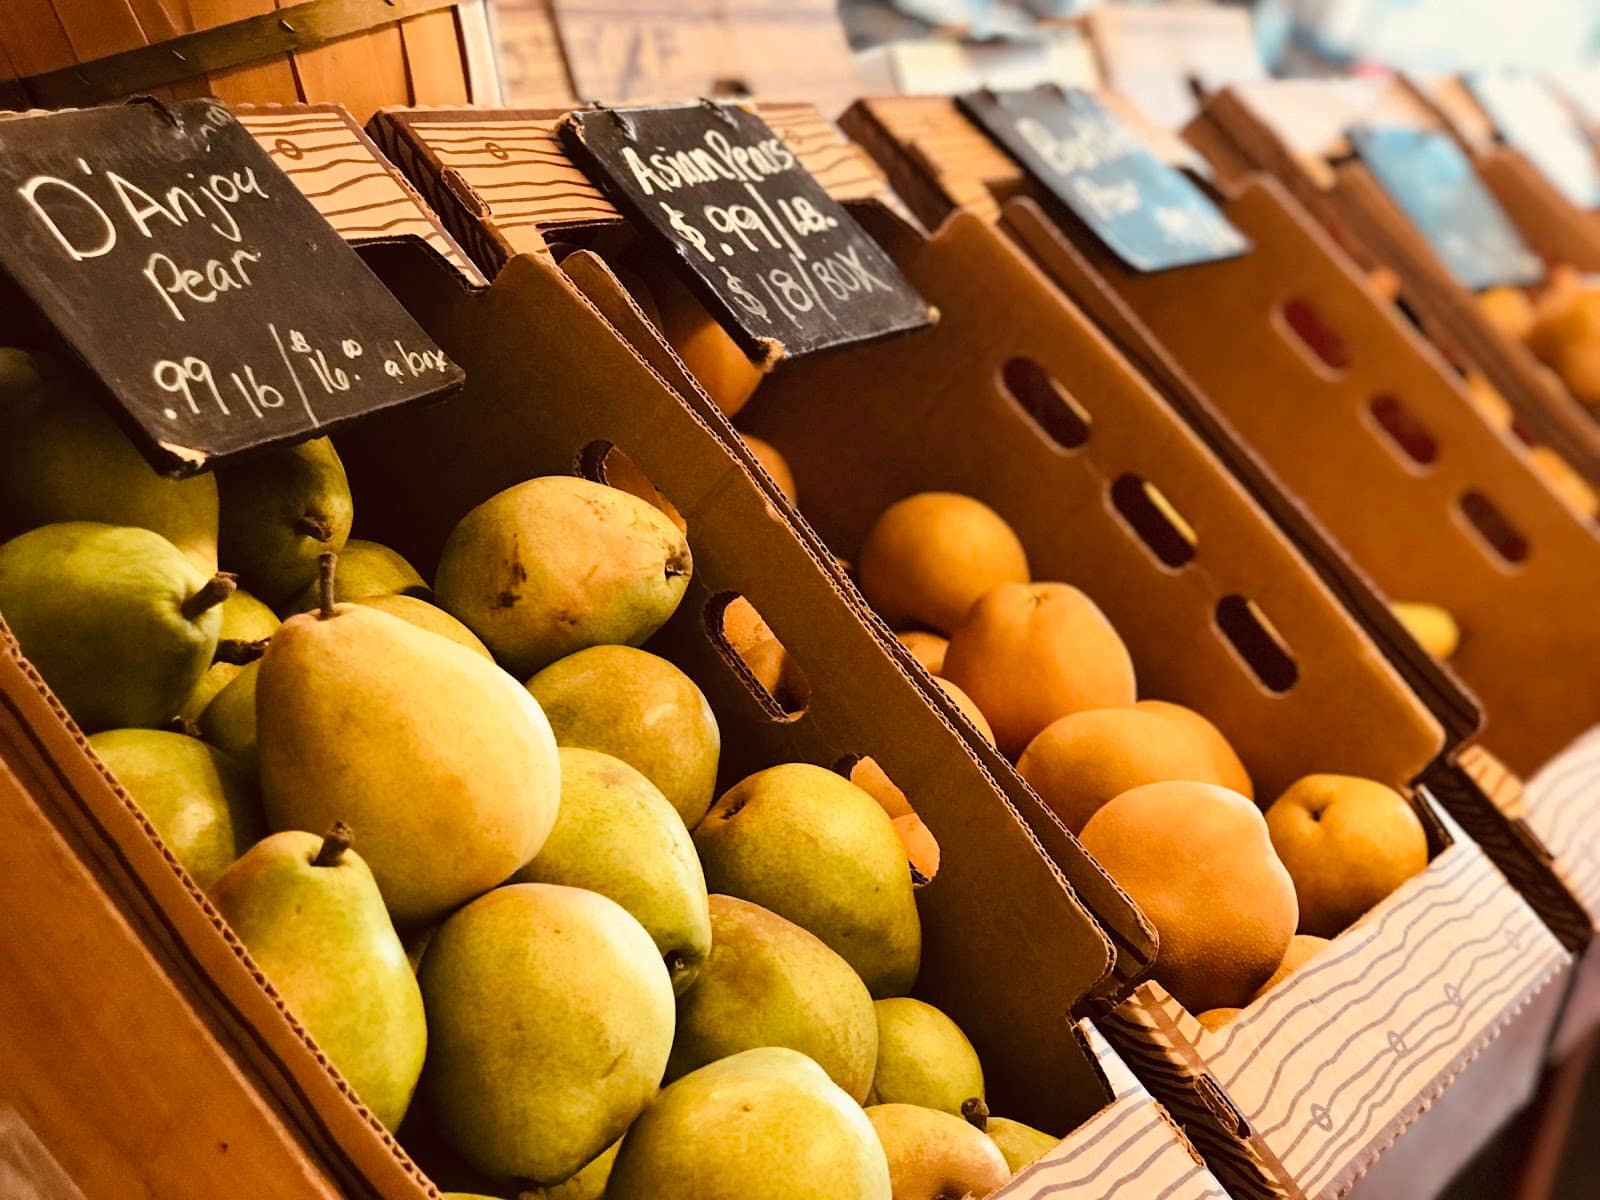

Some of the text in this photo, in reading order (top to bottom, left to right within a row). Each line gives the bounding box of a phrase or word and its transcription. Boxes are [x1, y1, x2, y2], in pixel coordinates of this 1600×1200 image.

[622, 129, 794, 195] Asian Pears
[18, 157, 270, 262] D'Anjou
